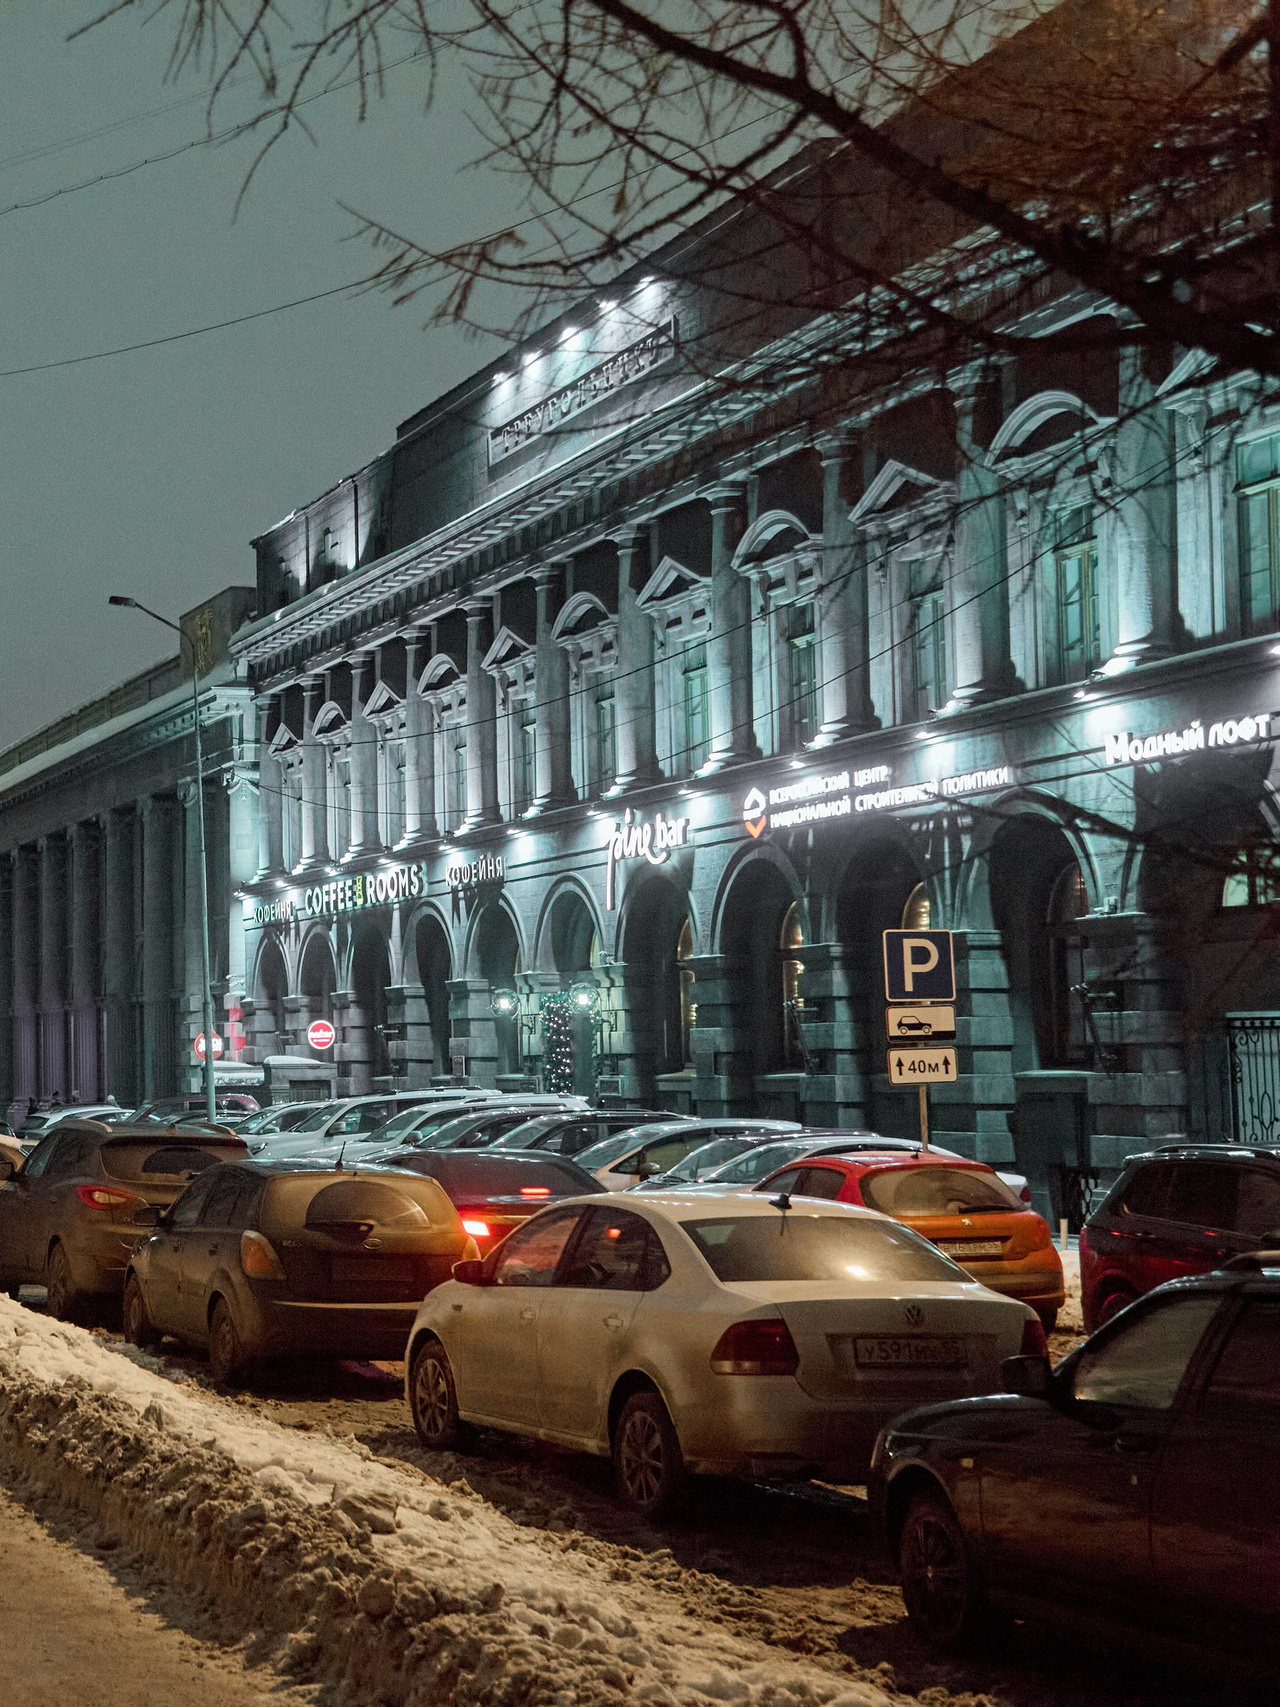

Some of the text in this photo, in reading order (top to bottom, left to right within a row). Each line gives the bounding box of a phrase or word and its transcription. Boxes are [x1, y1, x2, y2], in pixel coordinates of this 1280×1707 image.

[1105, 720, 1205, 765] Модный
[854, 765, 891, 788] ЦЕНТР
[770, 795, 851, 829] НАЦИОНАЛЬНОЙ
[946, 766, 1014, 796] ПОЛИТИКИ
[656, 813, 686, 849] bar
[305, 864, 421, 916] COFFEE ROOMS
[445, 855, 504, 886] КОФЕЙНЯ
[253, 898, 292, 924] КОФЕЙНЯ
[903, 938, 939, 992] P
